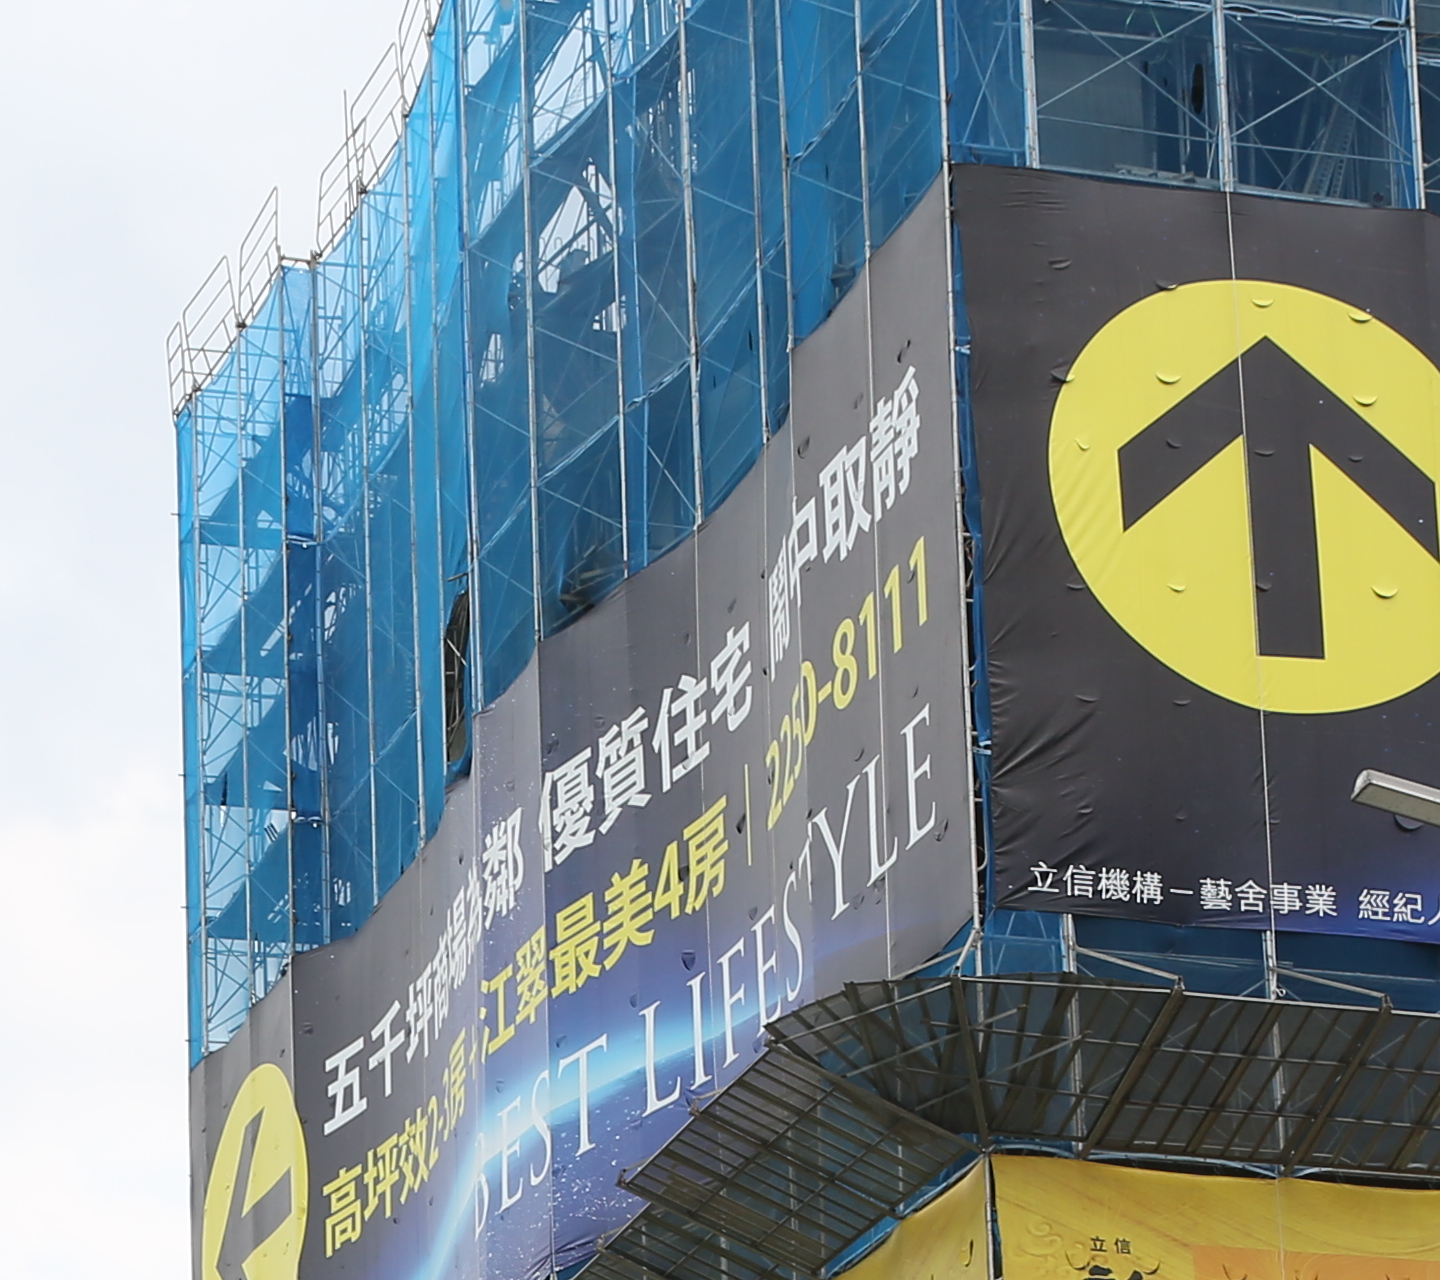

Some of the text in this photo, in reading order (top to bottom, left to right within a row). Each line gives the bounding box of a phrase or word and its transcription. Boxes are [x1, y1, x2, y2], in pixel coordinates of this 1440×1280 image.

[539, 620, 755, 873] 優質住宅
[765, 535, 930, 831] 2250-8111
[471, 1034, 610, 1242] BEST
[1090, 1235, 1132, 1256] 立信
